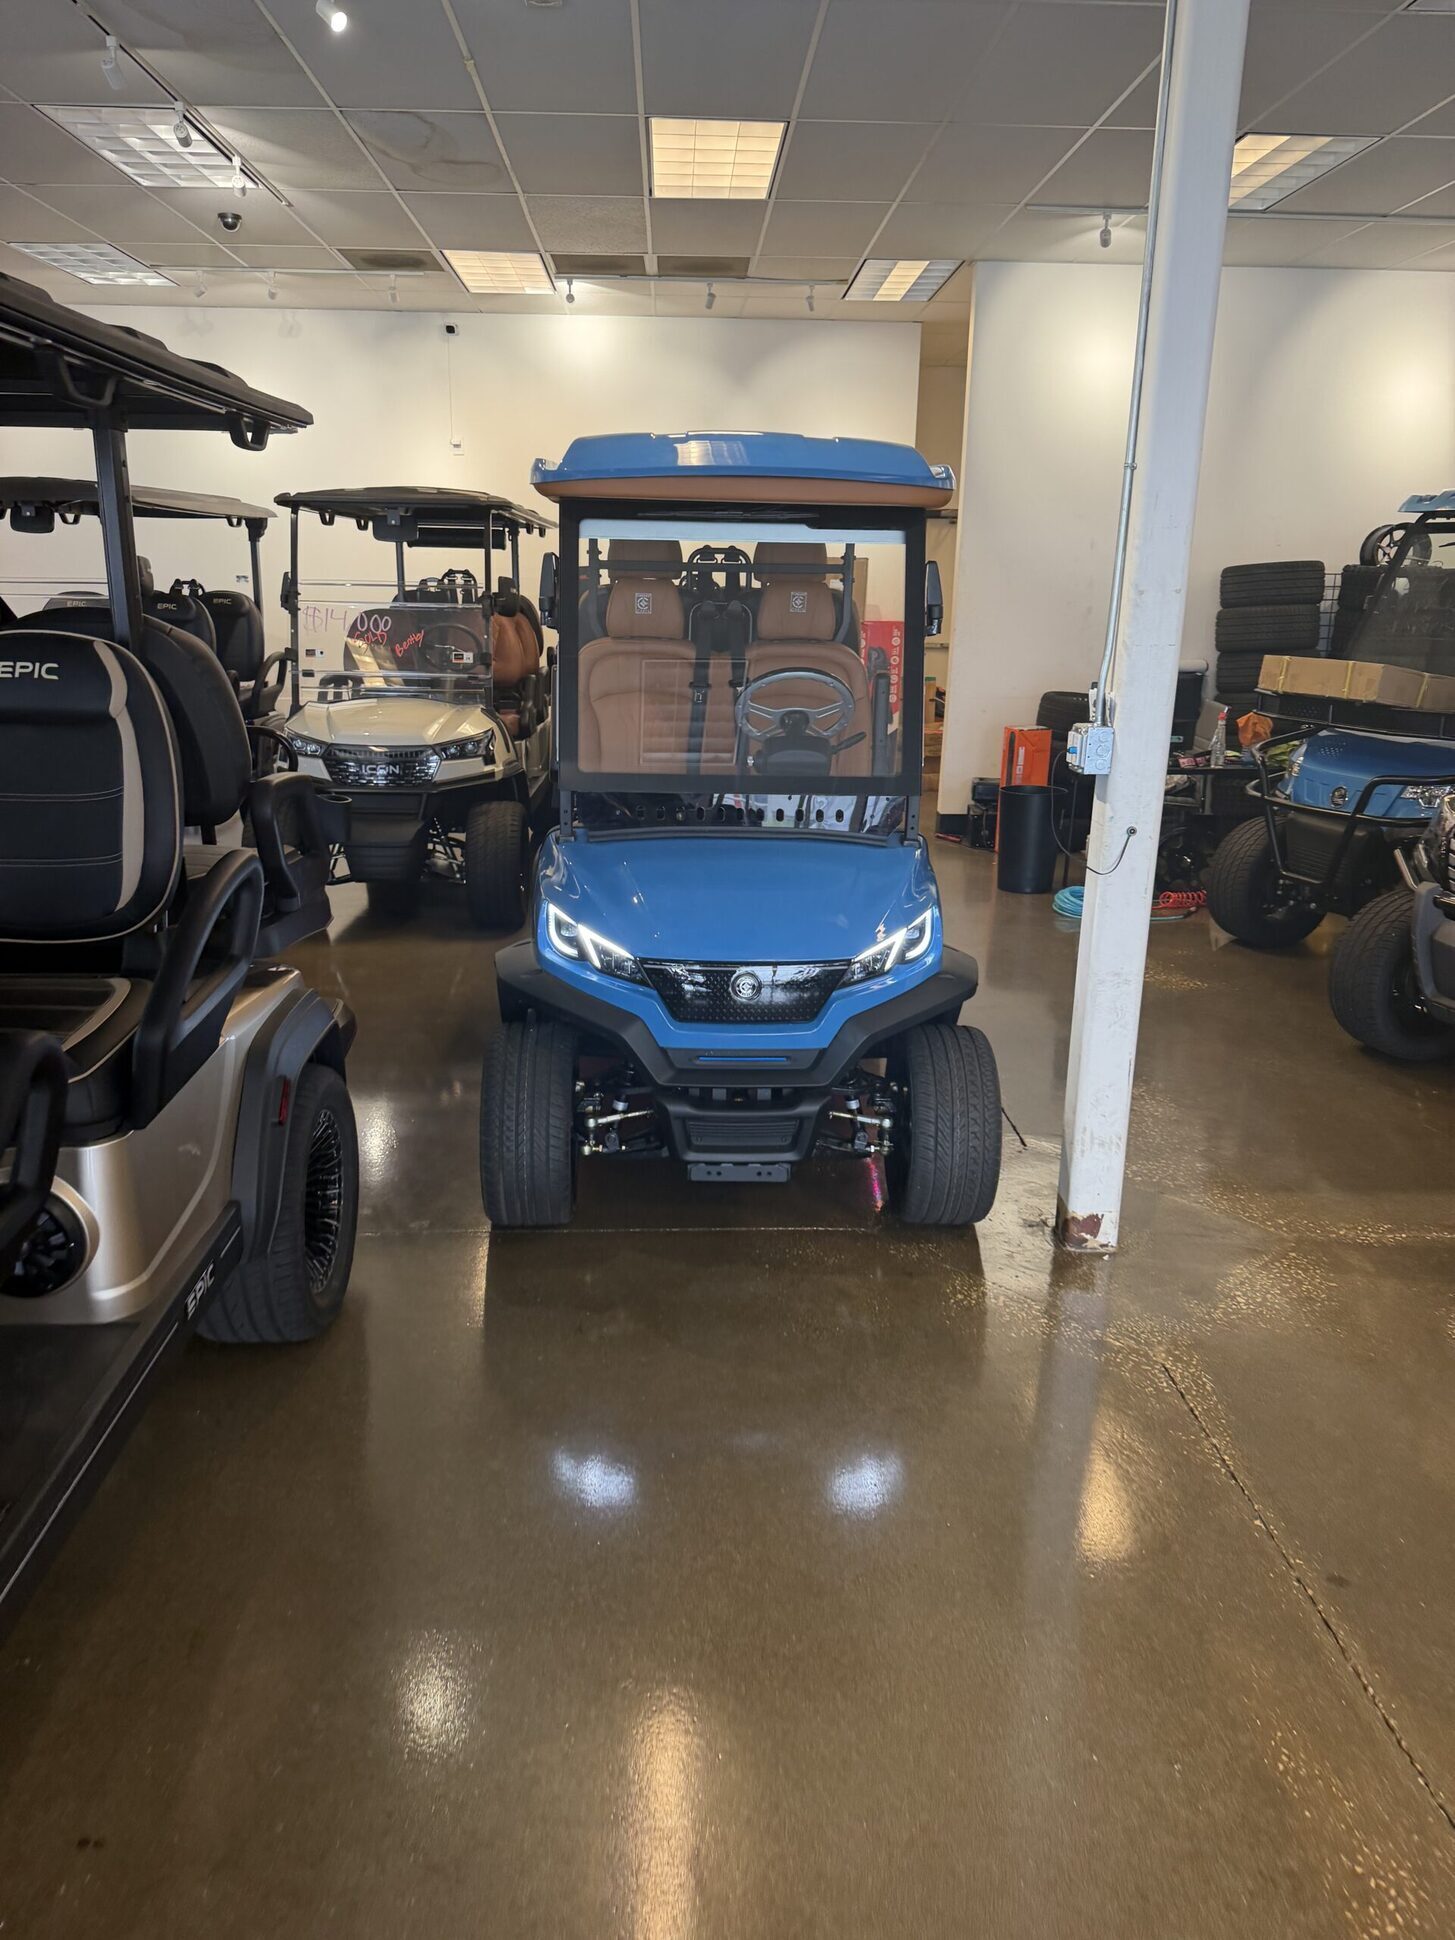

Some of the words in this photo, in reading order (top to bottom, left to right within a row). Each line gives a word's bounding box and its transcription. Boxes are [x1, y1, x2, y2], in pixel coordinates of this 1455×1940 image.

[157, 602, 177, 610] EPIC
[0, 661, 59, 680] EPIC
[362, 764, 399, 774] ICON
[186, 1263, 214, 1320] EPIC
